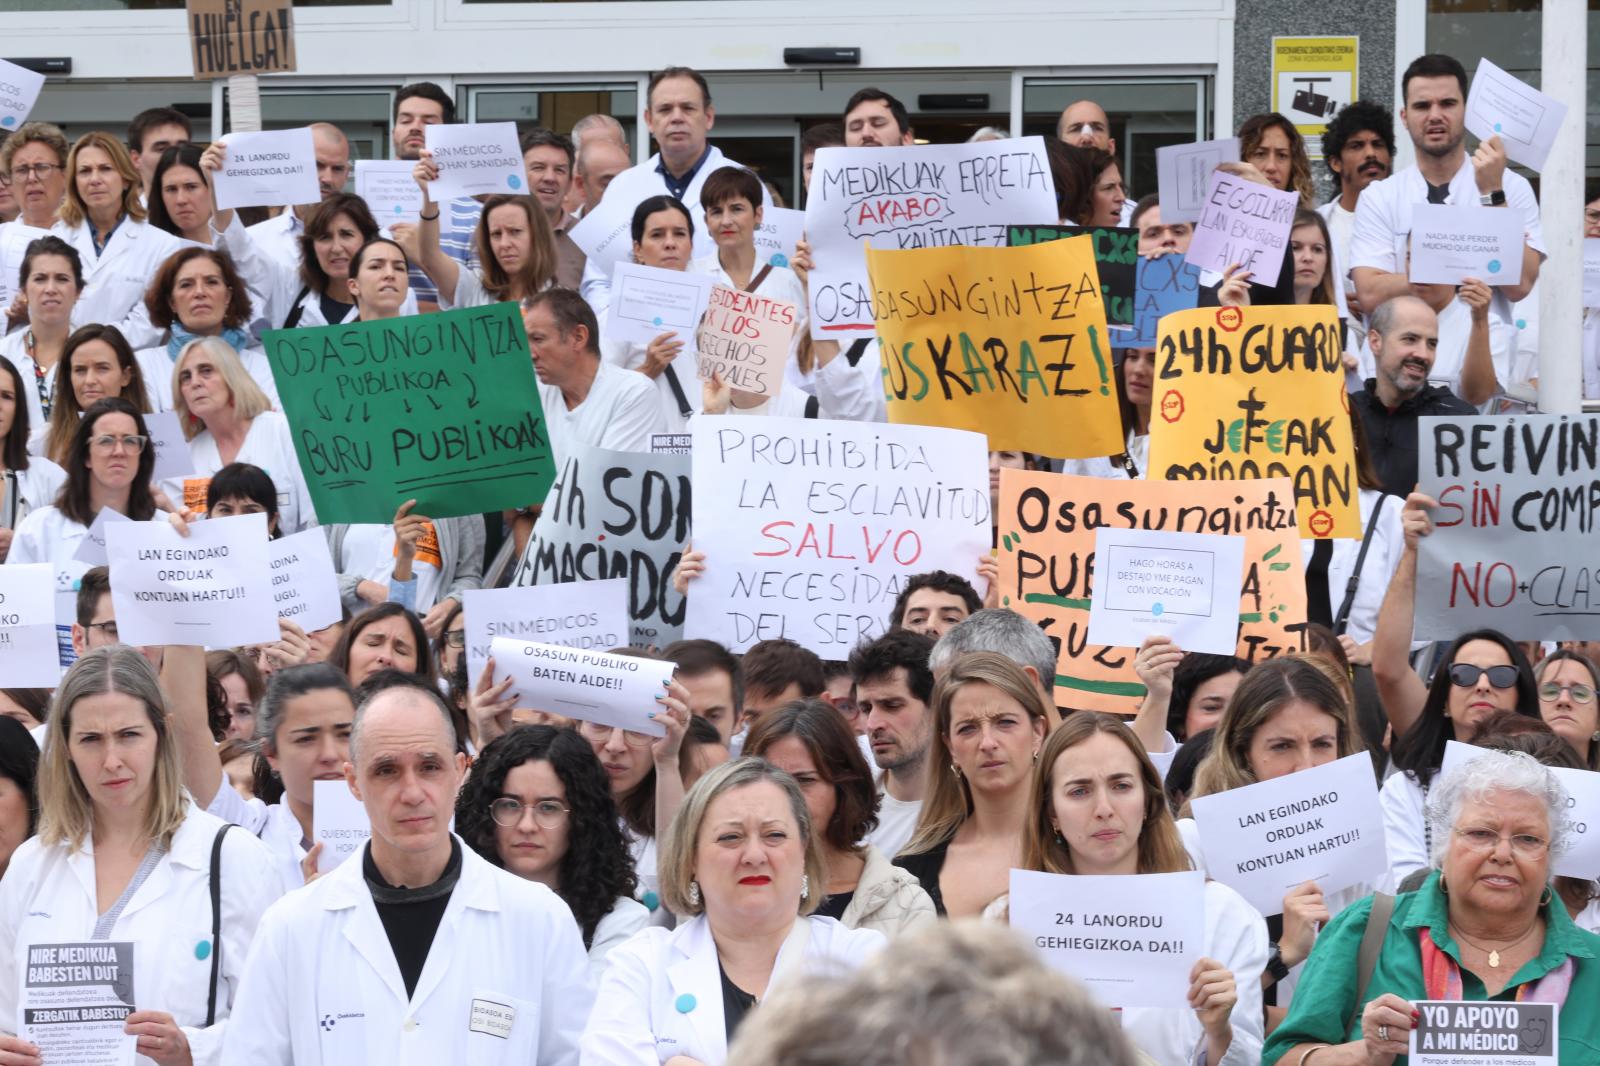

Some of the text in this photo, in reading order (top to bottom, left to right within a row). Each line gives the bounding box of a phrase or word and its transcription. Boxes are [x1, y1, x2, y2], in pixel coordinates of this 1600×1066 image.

[193, 8, 288, 73] HUELGA!
[234, 152, 291, 163] 24 LANORDU
[434, 144, 503, 158] SIN MÉDICOS
[226, 165, 304, 177] GEHIEGIZKOA DA!!
[447, 160, 469, 170] HAY
[471, 157, 518, 168] SANIDAD
[959, 152, 1048, 205] ERRETA
[858, 197, 942, 226] AKABO
[1201, 206, 1228, 231] LAN
[1422, 242, 1453, 250] MUCHO
[1454, 243, 1471, 252] QUE
[1425, 233, 1498, 243] NADA QUE PERDER
[720, 312, 761, 339] LOS
[277, 315, 524, 376] OSASUNGINTZA
[1160, 326, 1232, 380] 24h
[653, 436, 672, 447] NIRE
[302, 429, 373, 476] BURU
[738, 479, 779, 510] LA
[753, 520, 922, 566] SALVO
[138, 545, 229, 561] LAN EGINDAKO
[1129, 558, 1194, 571] HAGO HORAS A
[158, 568, 214, 582] ORDUAK
[1117, 571, 1153, 583] DESTAJO
[1174, 575, 1204, 585] PAGAN
[134, 586, 246, 602] KONTUAN HARTU!!
[1127, 585, 1191, 598] CON VOCACIÓN
[486, 612, 599, 637] SIN MÉDICOS
[634, 627, 657, 638] NO
[726, 611, 797, 645] DEL
[524, 645, 639, 673] OSASUN PUBLIKO
[533, 666, 623, 691] BATEN ALDE!!
[1238, 791, 1339, 829] LAN EGINDAKO
[321, 829, 352, 839] QUIERO
[1265, 817, 1325, 843] ORDUAK
[1236, 828, 1361, 874] KONTUAN HARTU!!
[1055, 912, 1163, 929] 24 LANORDU
[1034, 935, 1184, 954] GEHIEGIZKOA DA!!
[30, 946, 118, 965] NIRE MEDIKUA
[28, 966, 119, 983] BABESTEN DUT
[32, 1007, 130, 1023] ZERGATIK BABESTU?
[1422, 1005, 1519, 1029] YO APOYO
[1422, 1028, 1519, 1051] A MI MÉDICO
[1422, 1057, 1449, 1066] Porque
[1451, 1057, 1484, 1065] defender
